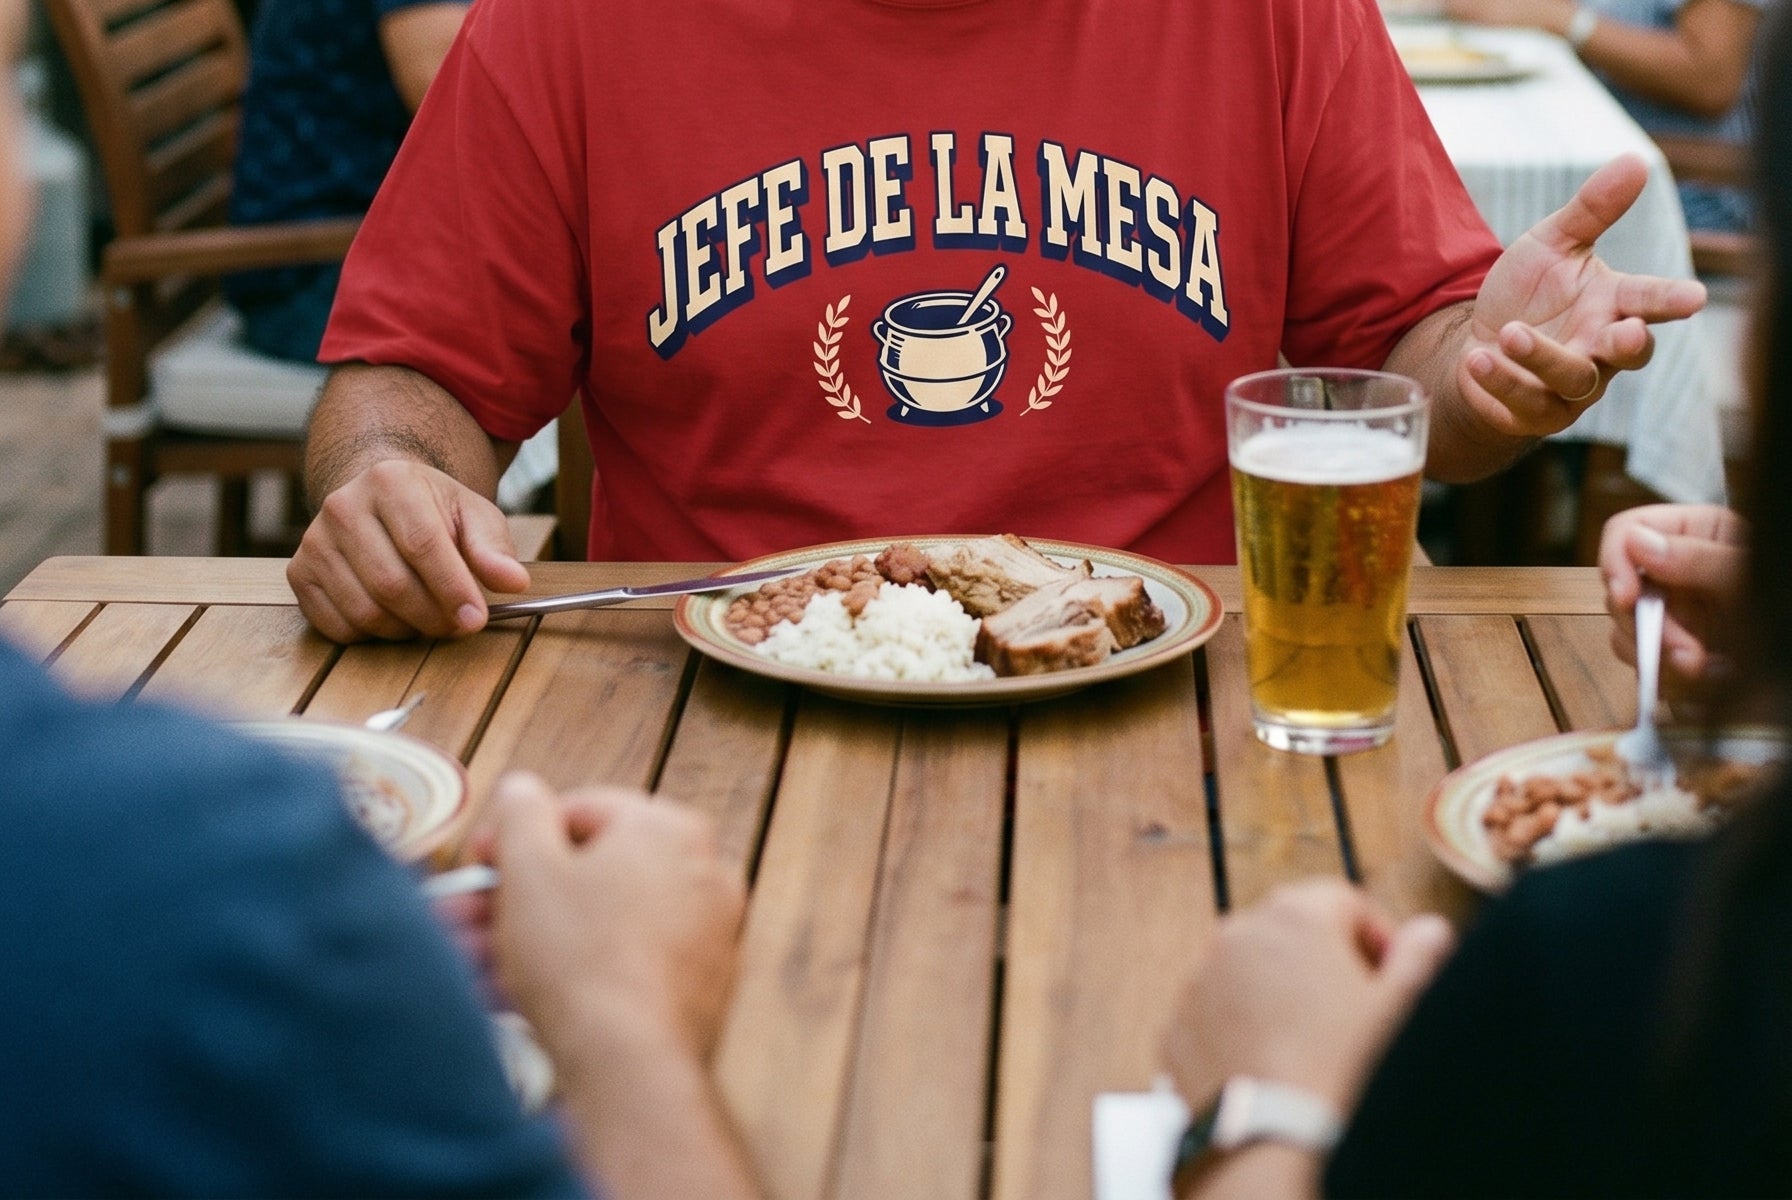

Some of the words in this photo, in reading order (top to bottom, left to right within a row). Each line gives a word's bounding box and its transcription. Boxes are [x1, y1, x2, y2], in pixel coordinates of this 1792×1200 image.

[647, 158, 810, 357] JEFE
[822, 135, 914, 265] DE
[930, 132, 1028, 251] LA
[1038, 141, 1230, 341] MESA
